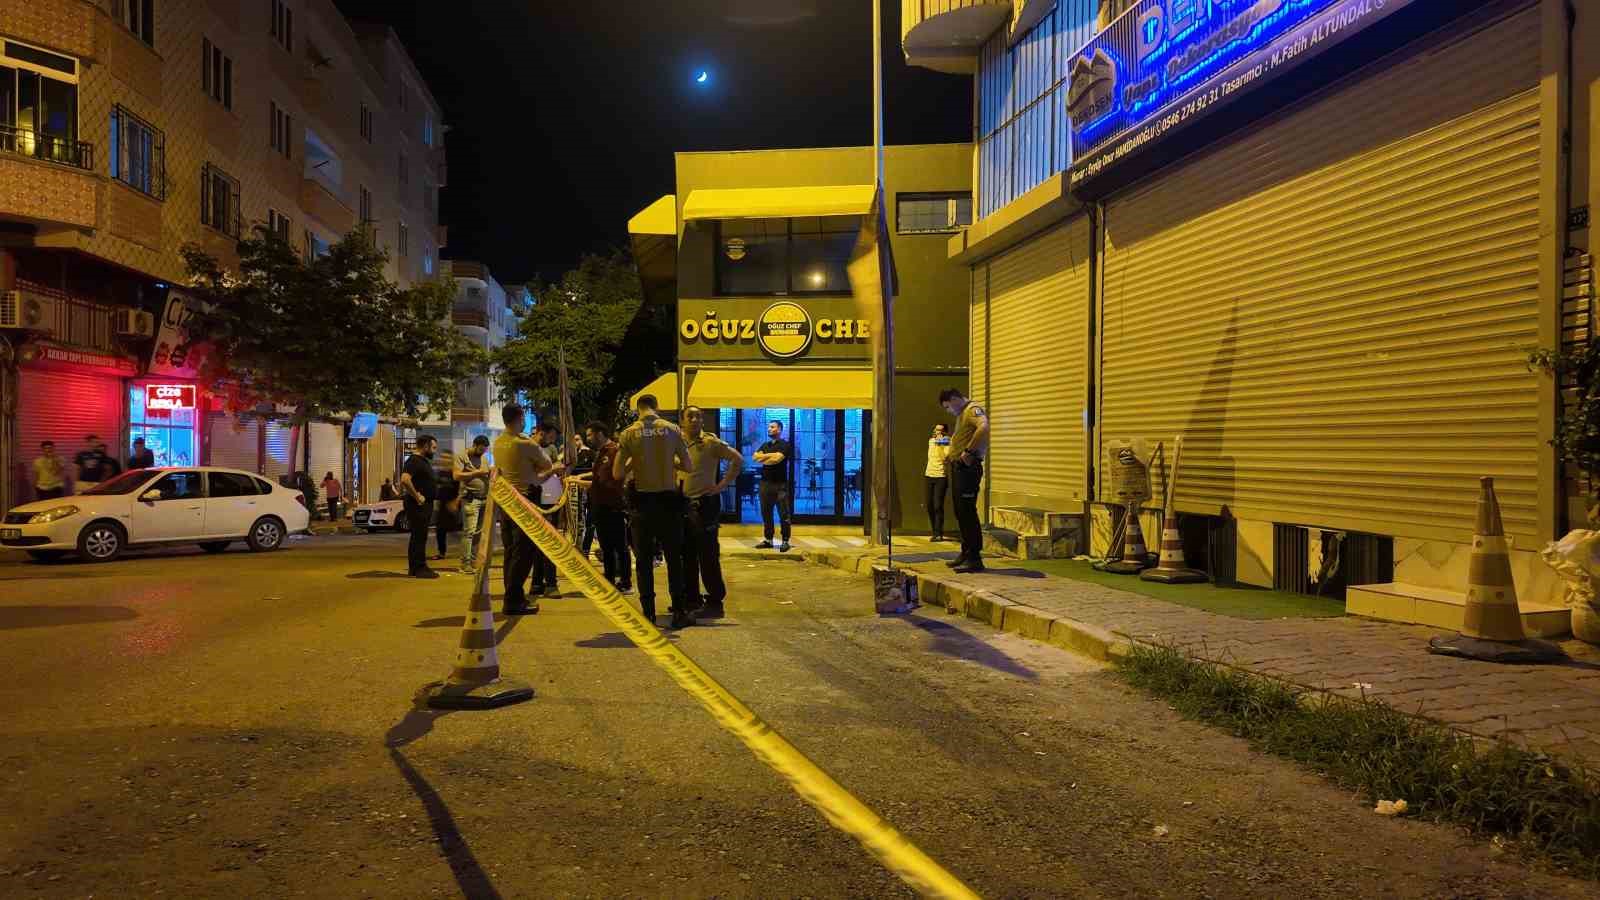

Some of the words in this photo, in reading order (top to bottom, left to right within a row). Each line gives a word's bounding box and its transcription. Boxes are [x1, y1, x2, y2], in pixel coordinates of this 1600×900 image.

[1161, 111, 1180, 130] 0546
[1180, 100, 1196, 120] 274
[1197, 94, 1208, 111] 92
[1209, 88, 1219, 104] 31
[1221, 64, 1263, 97] Tasarımcı
[1270, 35, 1308, 69] M.Fatih
[1310, 4, 1373, 46] ALTUNDAL
[680, 311, 755, 339] OĞUZ
[815, 319, 871, 338] CHE
[767, 322, 785, 330] OĞUZ
